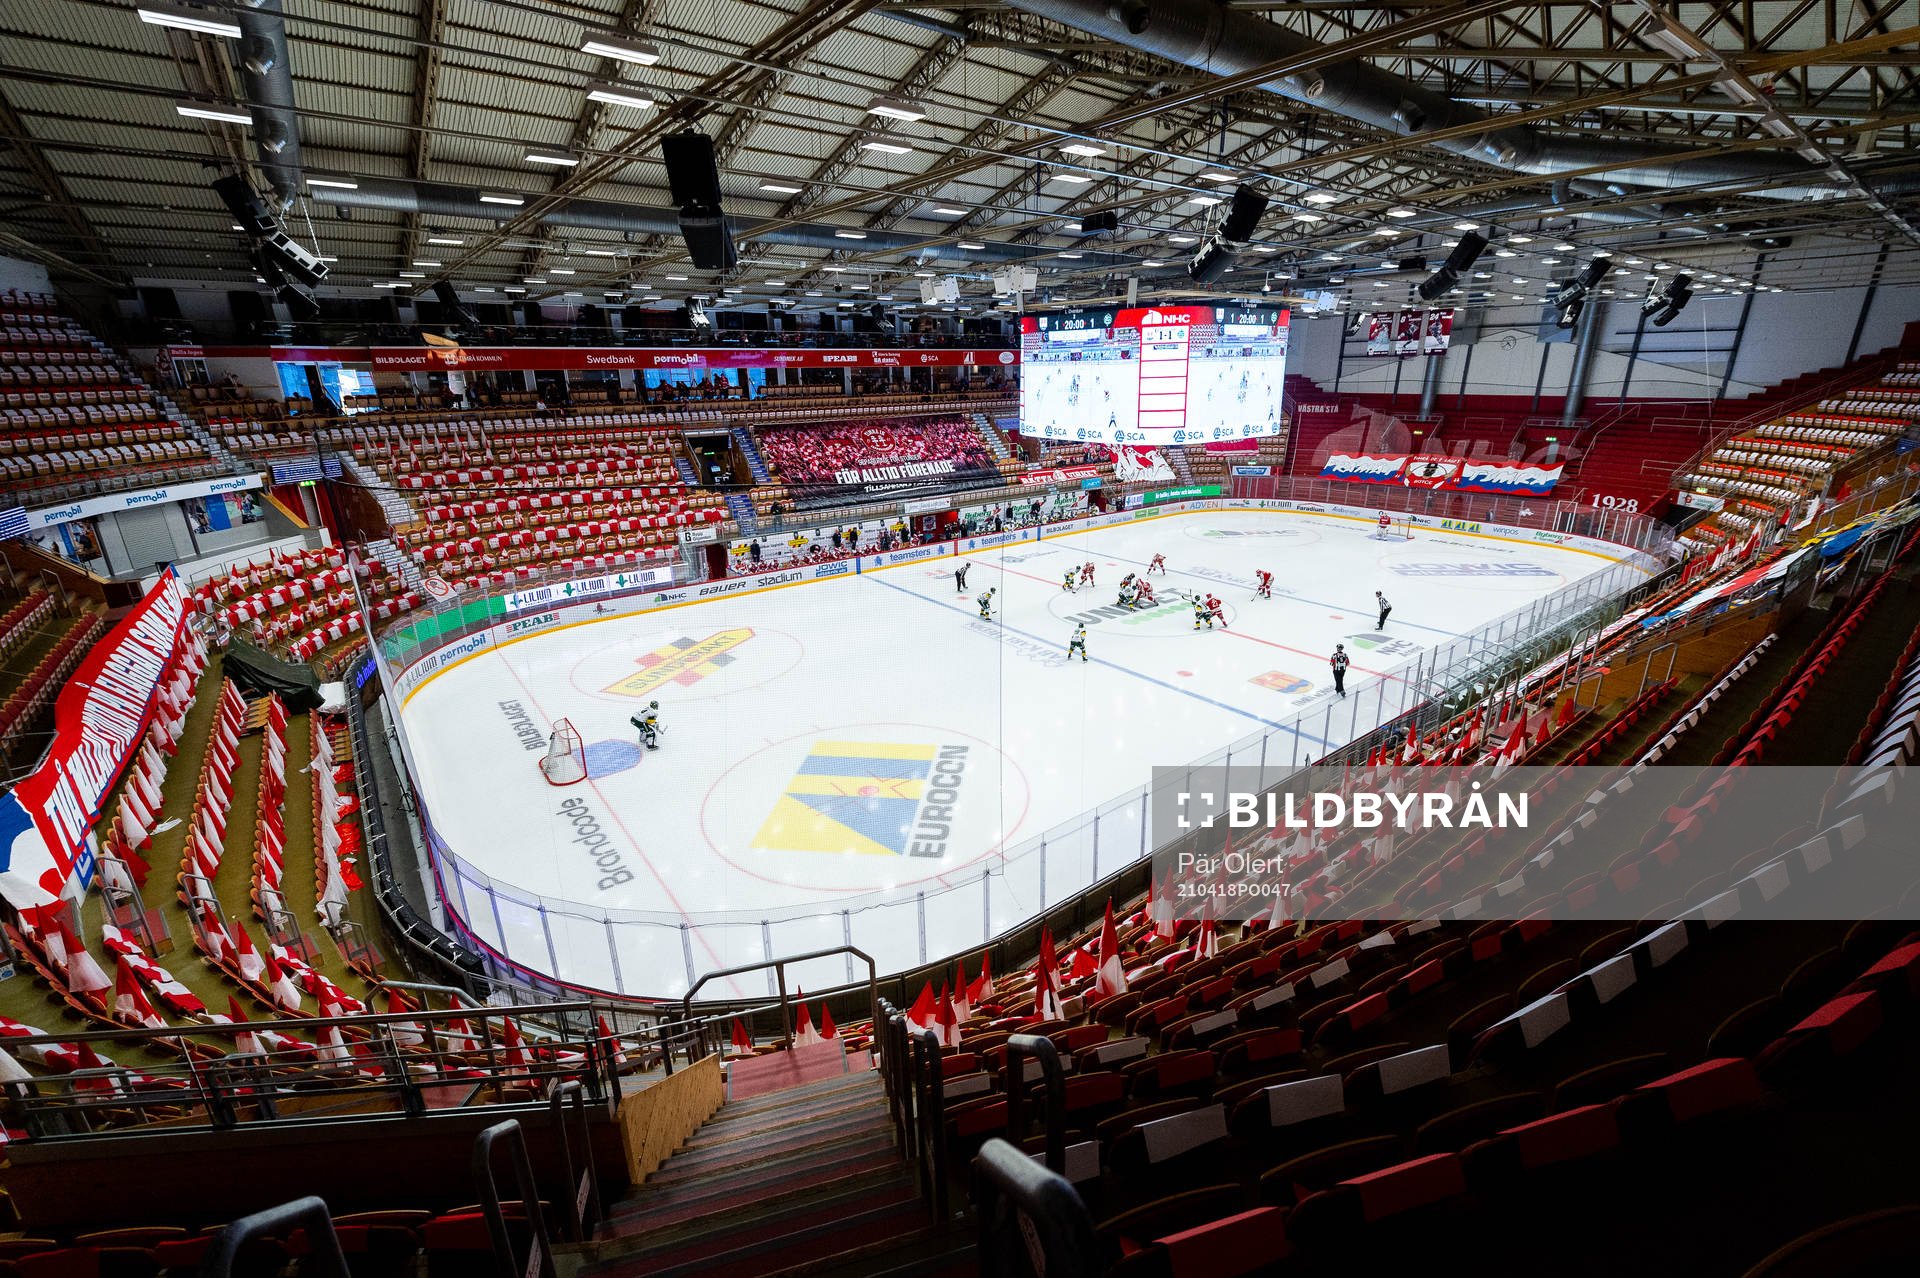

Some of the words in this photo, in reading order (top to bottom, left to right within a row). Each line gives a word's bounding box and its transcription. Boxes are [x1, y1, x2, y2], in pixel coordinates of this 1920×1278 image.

[1055, 321, 1059, 330] 1
[1064, 319, 1085, 330] 20:00
[1090, 318, 1094, 328] 1
[1163, 314, 1191, 324] NHC
[1231, 313, 1235, 324] 1
[1239, 314, 1257, 324] 20:00
[1261, 315, 1265, 324] 1
[1160, 331, 1172, 340] 1-1
[375, 356, 426, 364] BILBOLAGET
[476, 354, 503, 362] KOMMUN
[586, 355, 635, 364] Swedbank
[653, 353, 699, 365] permobil
[1298, 403, 1324, 413] VÄSTRA
[1053, 428, 1067, 436] SCA
[1087, 431, 1102, 439] SCA
[1127, 432, 1145, 440] SCA
[1188, 432, 1204, 440] SCA
[835, 467, 861, 485] FÖR
[862, 465, 900, 482] ALLTID
[899, 460, 956, 478] FÖRENADE
[210, 478, 247, 492] permobil
[126, 490, 168, 506] permobil
[1266, 500, 1292, 508] LILIUM
[1592, 493, 1639, 514] 1928
[1189, 501, 1219, 510] ADVEN
[1296, 505, 1325, 513] Faradium
[44, 504, 82, 523] permobil
[1046, 524, 1074, 534] BILBOLAGET
[1493, 527, 1519, 537] winpos
[981, 532, 1017, 545] teamsters
[889, 548, 931, 562] teamsters
[816, 561, 848, 572] JOWIC
[629, 571, 656, 584] LILIUM
[758, 571, 802, 587] stadium
[576, 578, 605, 592] LILIUM
[699, 581, 747, 596] BAUER
[523, 588, 552, 603] LILIUM
[668, 592, 687, 600] NHC
[512, 614, 555, 632] PEAB
[129, 609, 176, 659] SOM
[440, 633, 487, 665] permobil
[96, 637, 165, 704] FLAGGAN
[411, 655, 438, 681] LILIUM
[498, 700, 547, 751] BILBOLAGET
[43, 757, 89, 861] TVÅ
